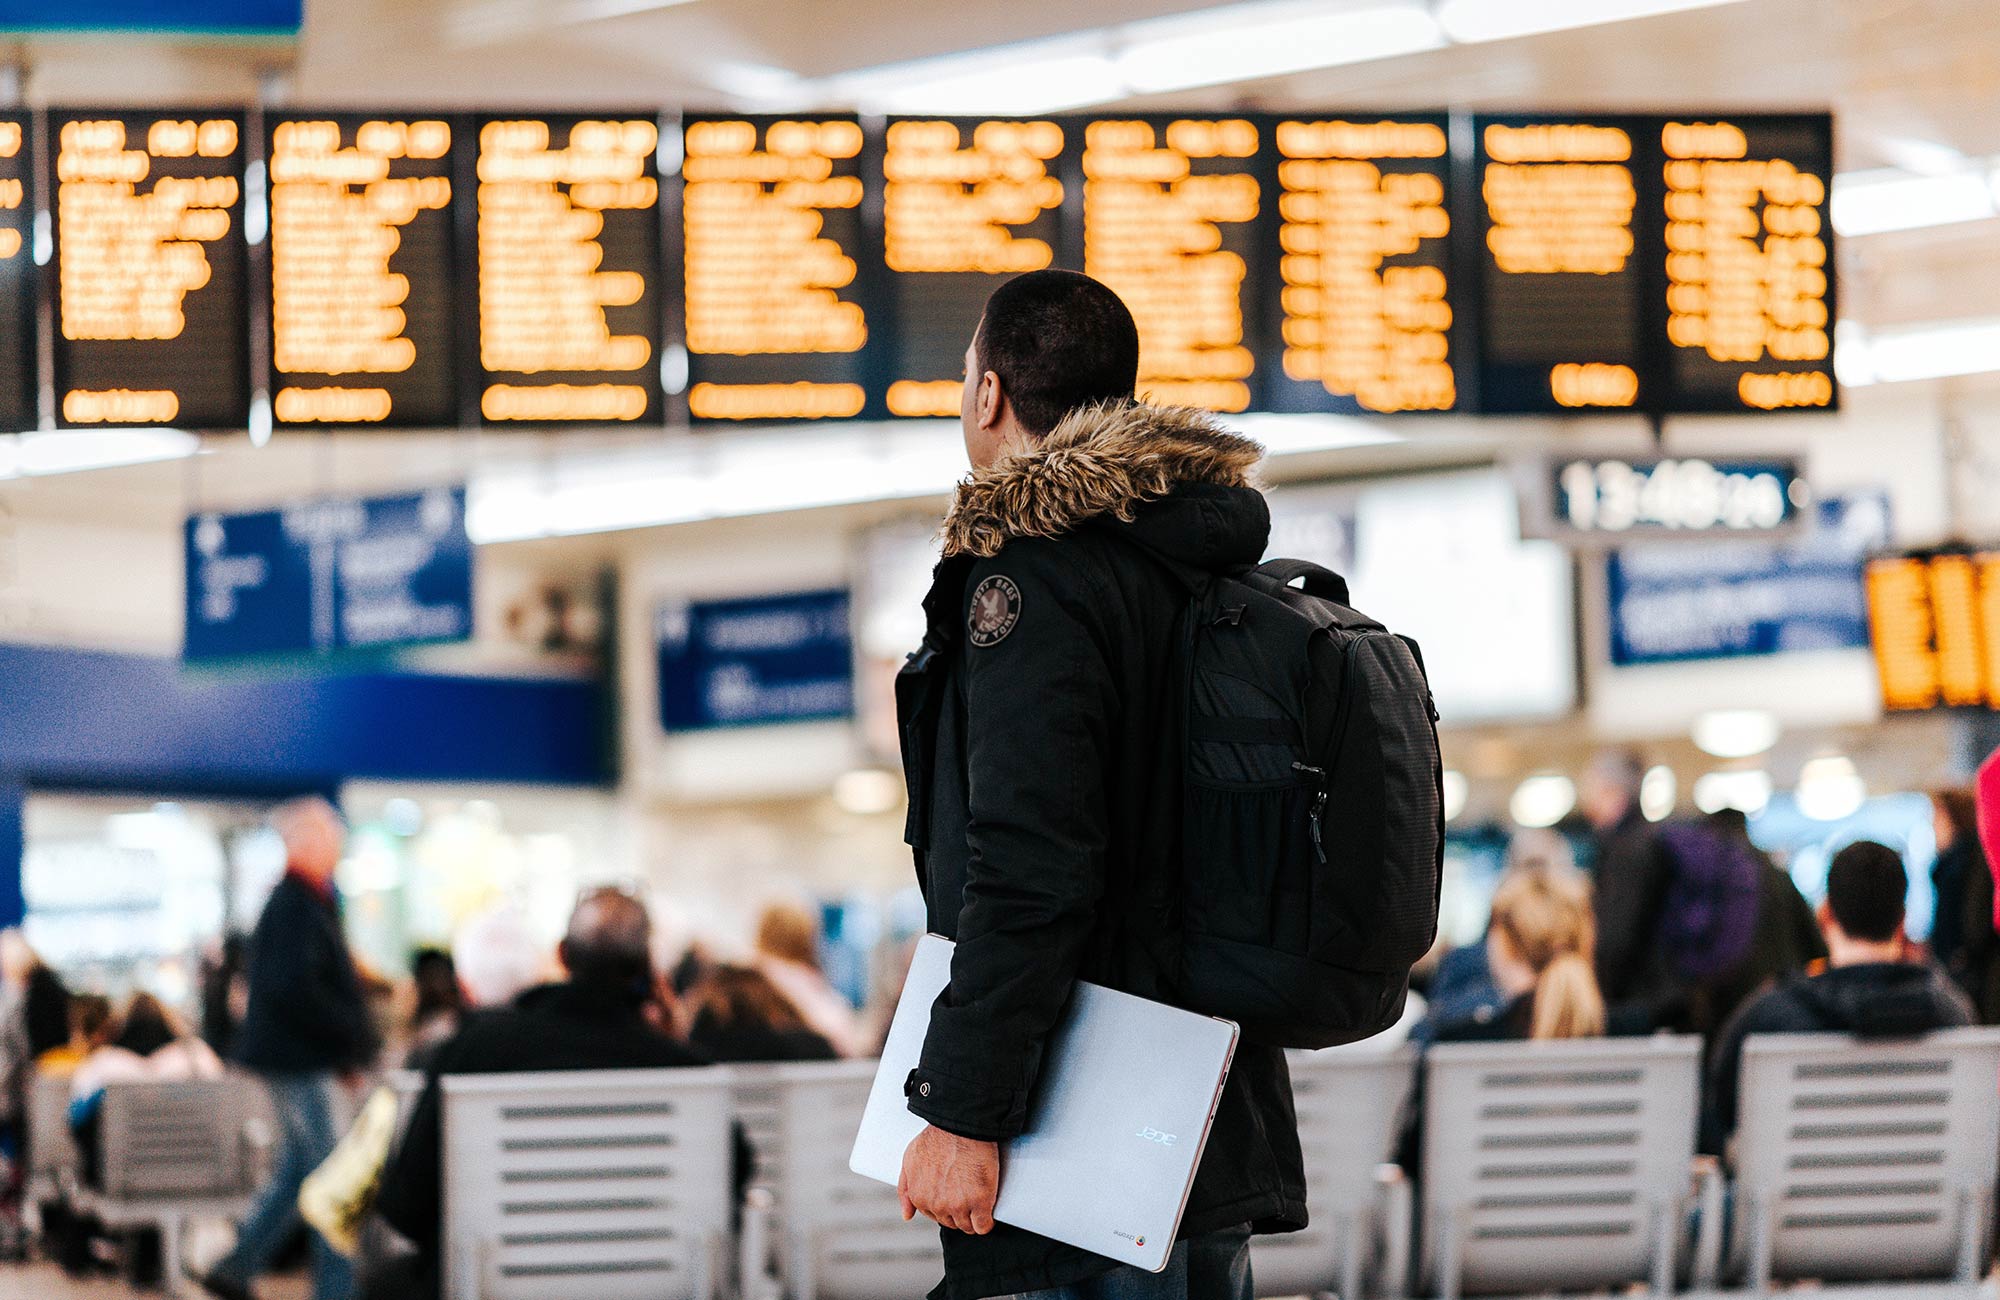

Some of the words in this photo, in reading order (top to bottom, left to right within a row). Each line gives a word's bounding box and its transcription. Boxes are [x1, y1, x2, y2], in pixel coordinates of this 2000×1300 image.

[995, 579, 1017, 600] BROS
[992, 612, 1015, 638] YORK
[1135, 1126, 1177, 1146] acer
